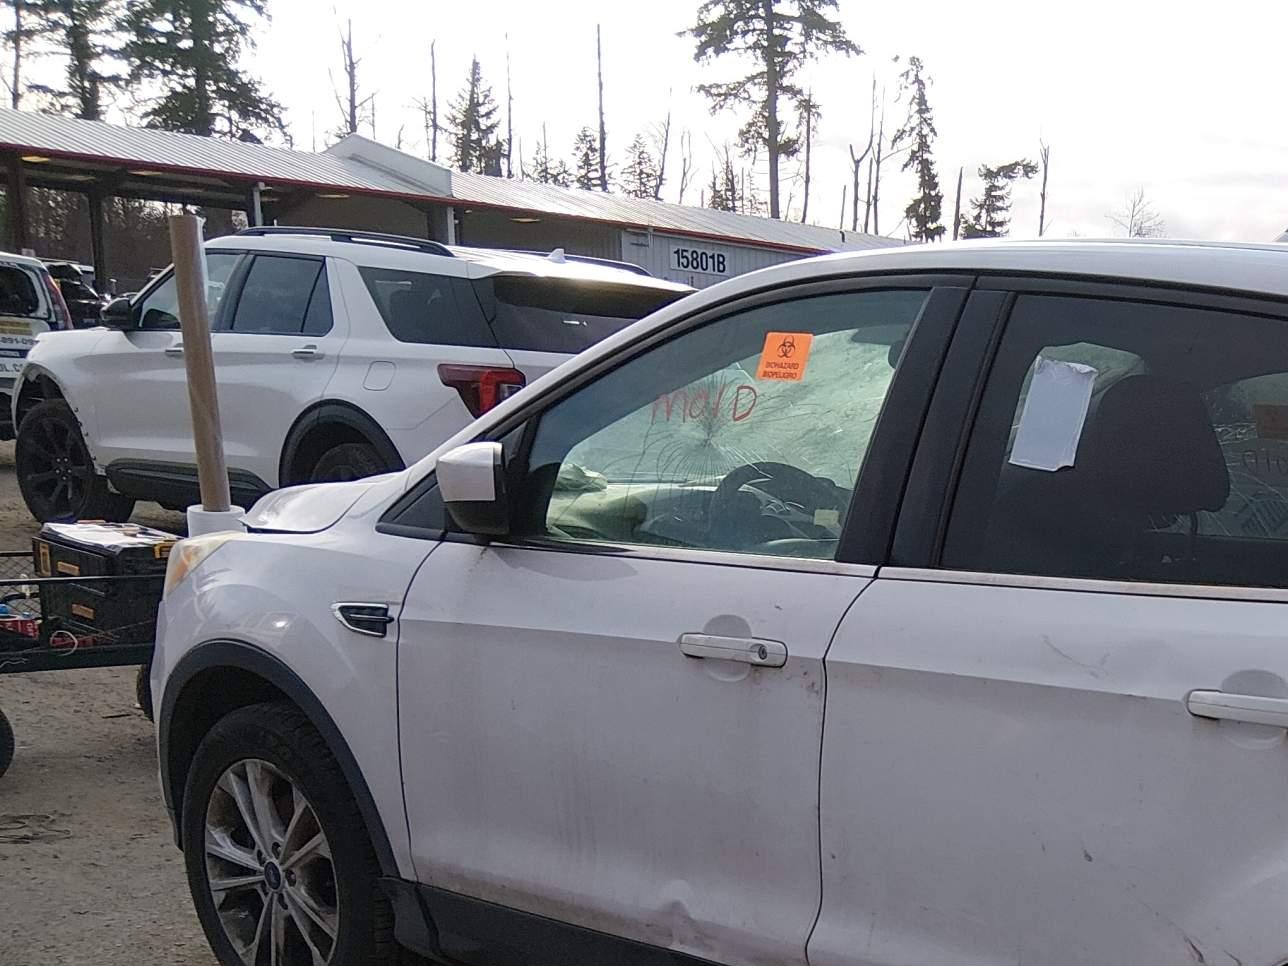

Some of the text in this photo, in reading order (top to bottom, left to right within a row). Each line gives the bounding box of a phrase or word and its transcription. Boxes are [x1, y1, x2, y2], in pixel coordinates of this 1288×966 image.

[673, 248, 726, 273] 15801B
[765, 361, 800, 370] BIOHAZARD
[761, 370, 798, 380] BIOPELIGRO
